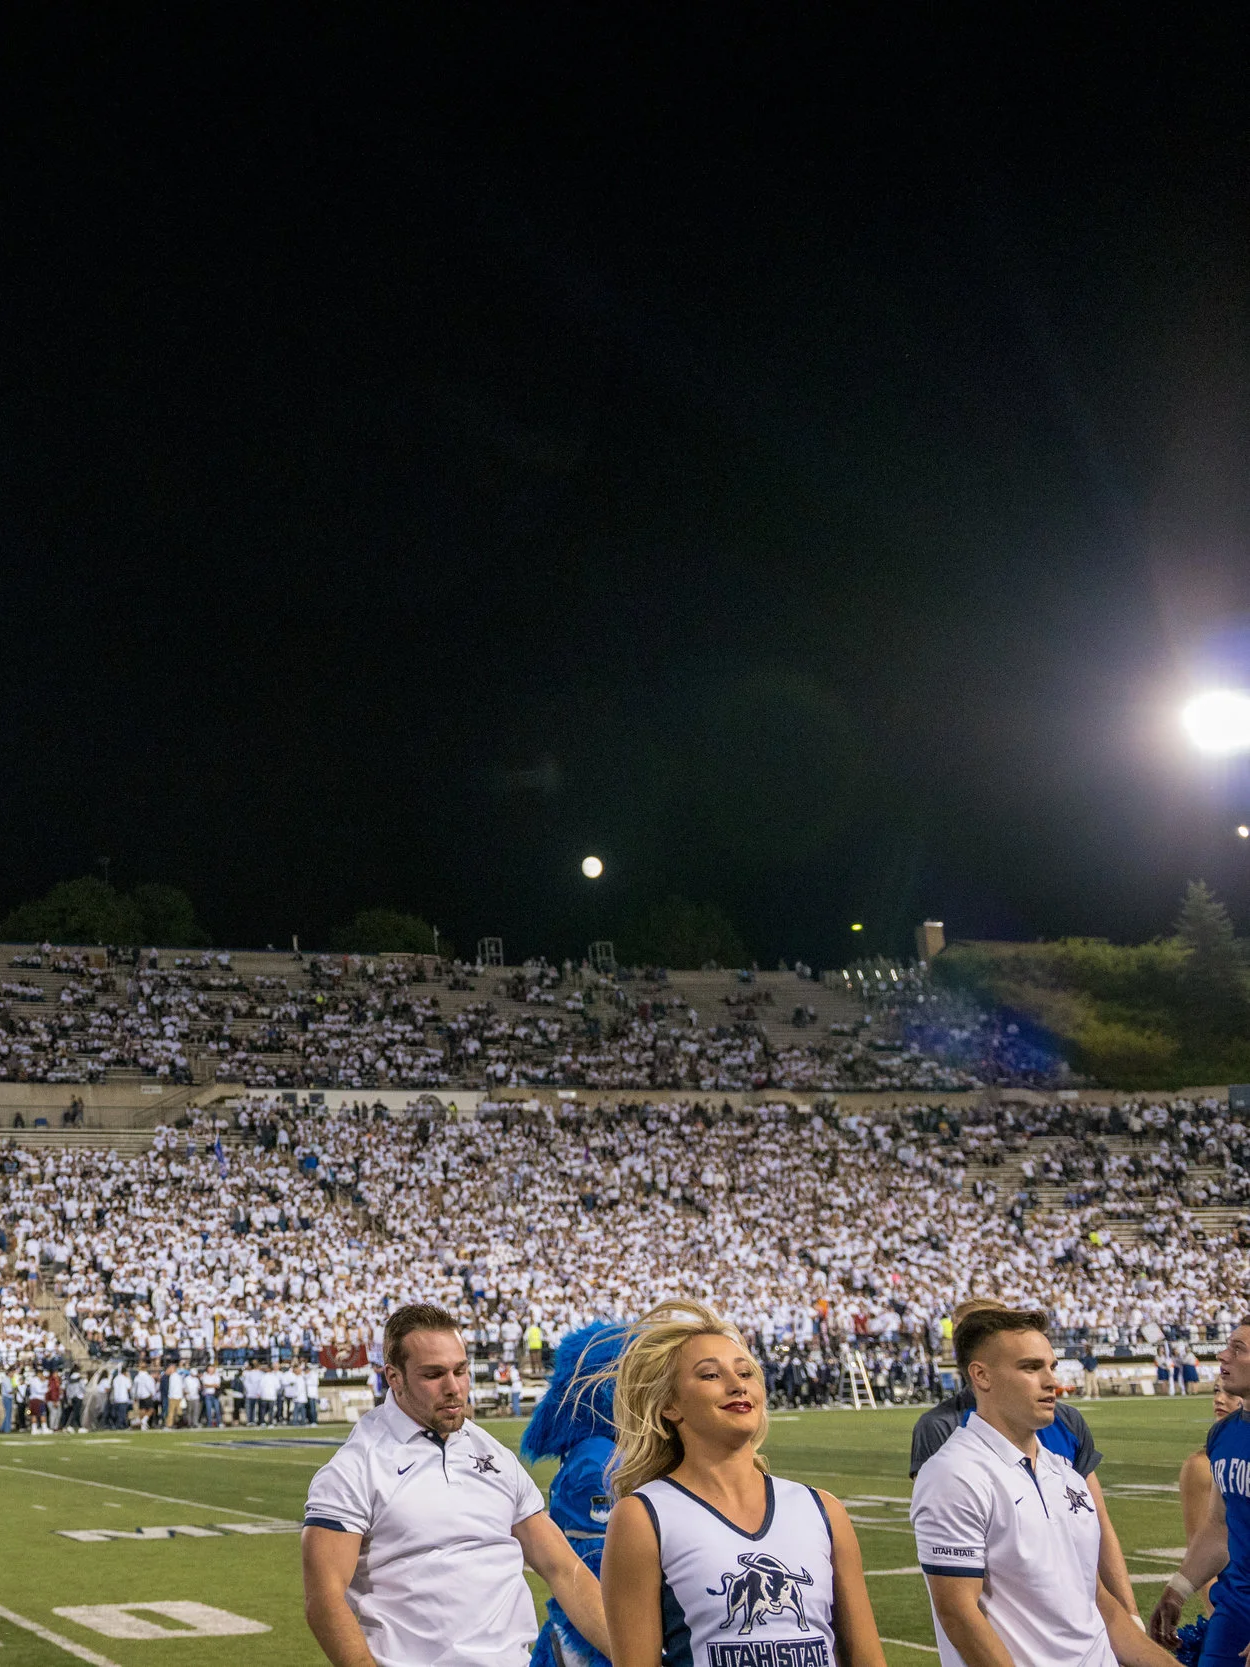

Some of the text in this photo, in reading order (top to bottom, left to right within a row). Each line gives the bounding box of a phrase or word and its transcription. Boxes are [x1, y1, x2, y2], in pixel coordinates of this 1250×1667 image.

[932, 1547, 975, 1558] UTAH STATE
[707, 1636, 830, 1667] UTAH STATE
